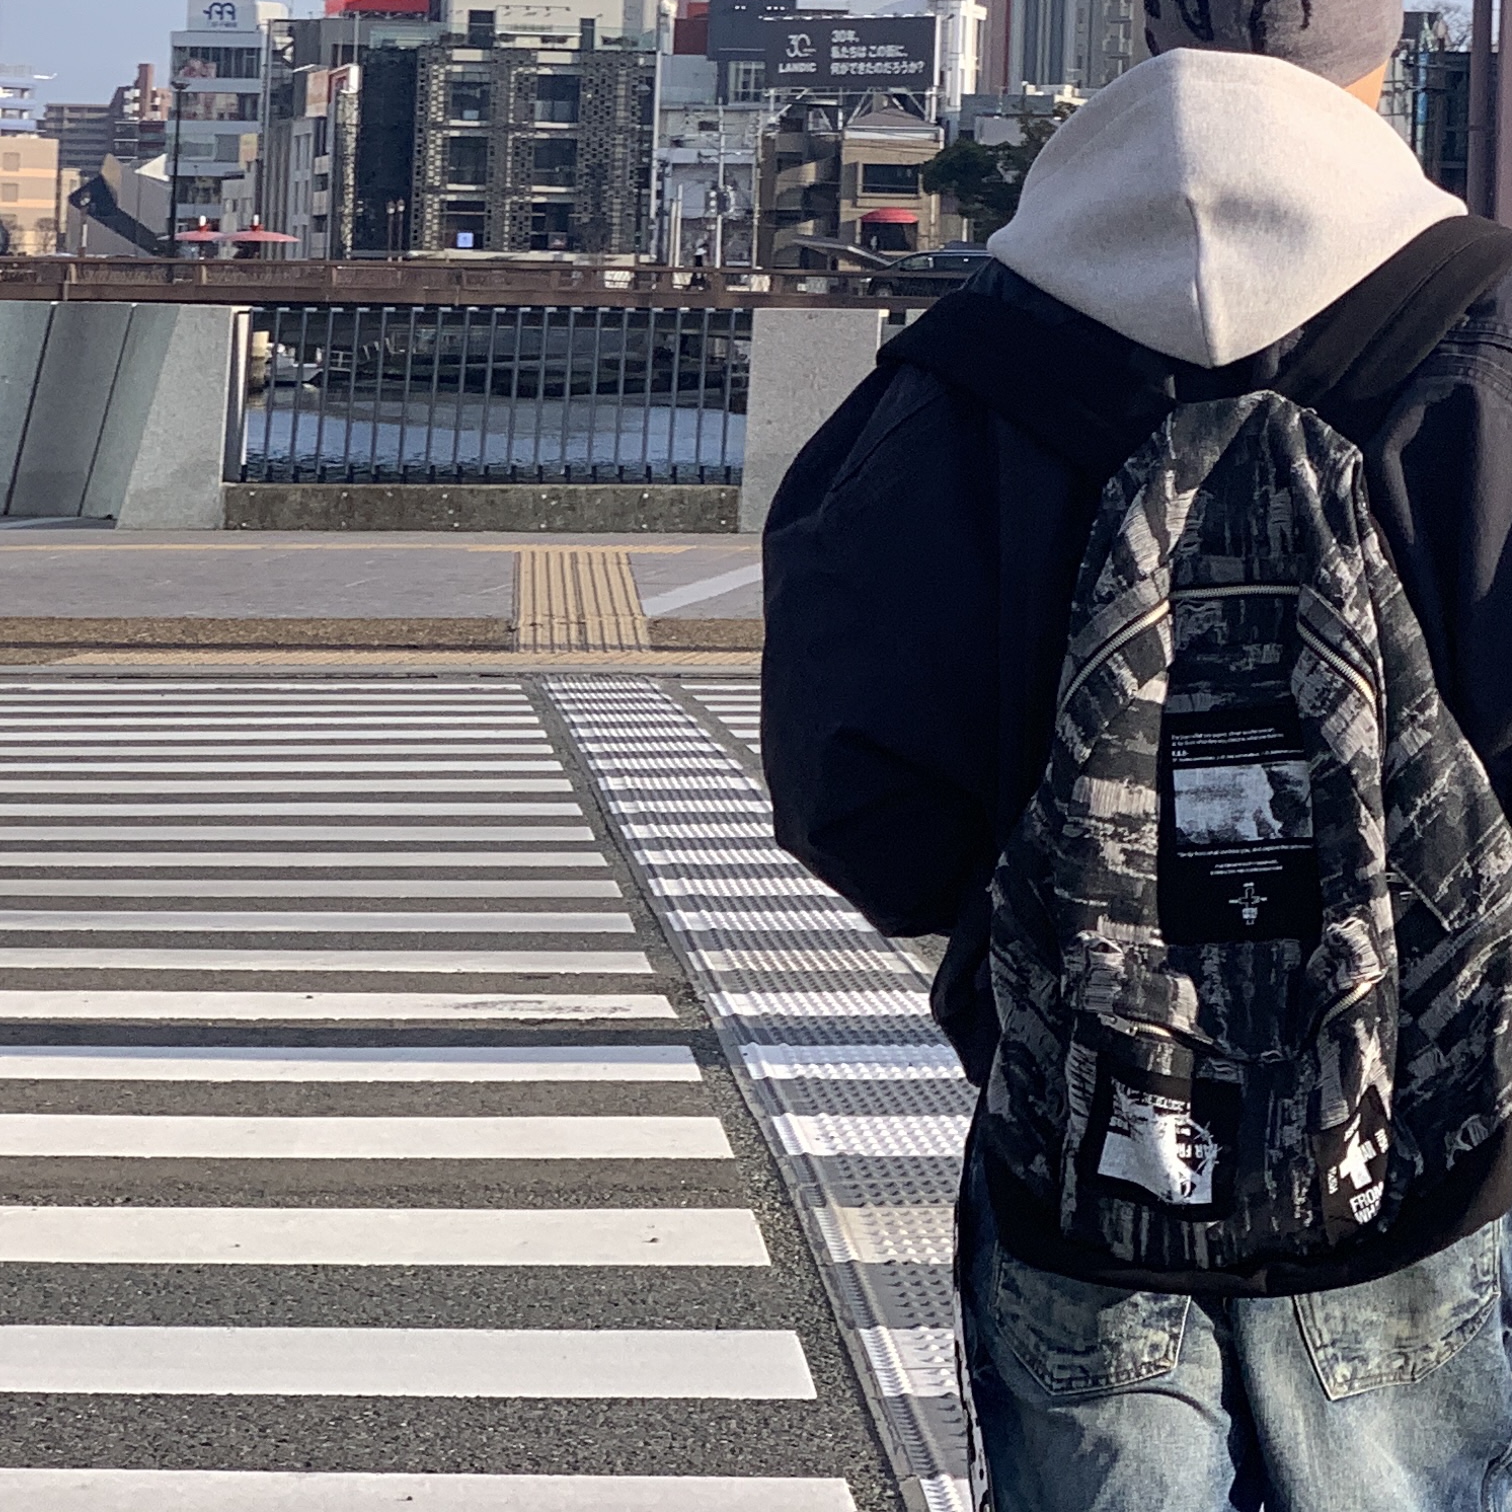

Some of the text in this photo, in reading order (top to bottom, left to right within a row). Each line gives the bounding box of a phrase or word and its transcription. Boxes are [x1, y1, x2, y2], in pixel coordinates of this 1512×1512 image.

[778, 62, 817, 73] LANDIC
[1349, 1181, 1384, 1213] FROM
[1354, 1199, 1380, 1224] WH
